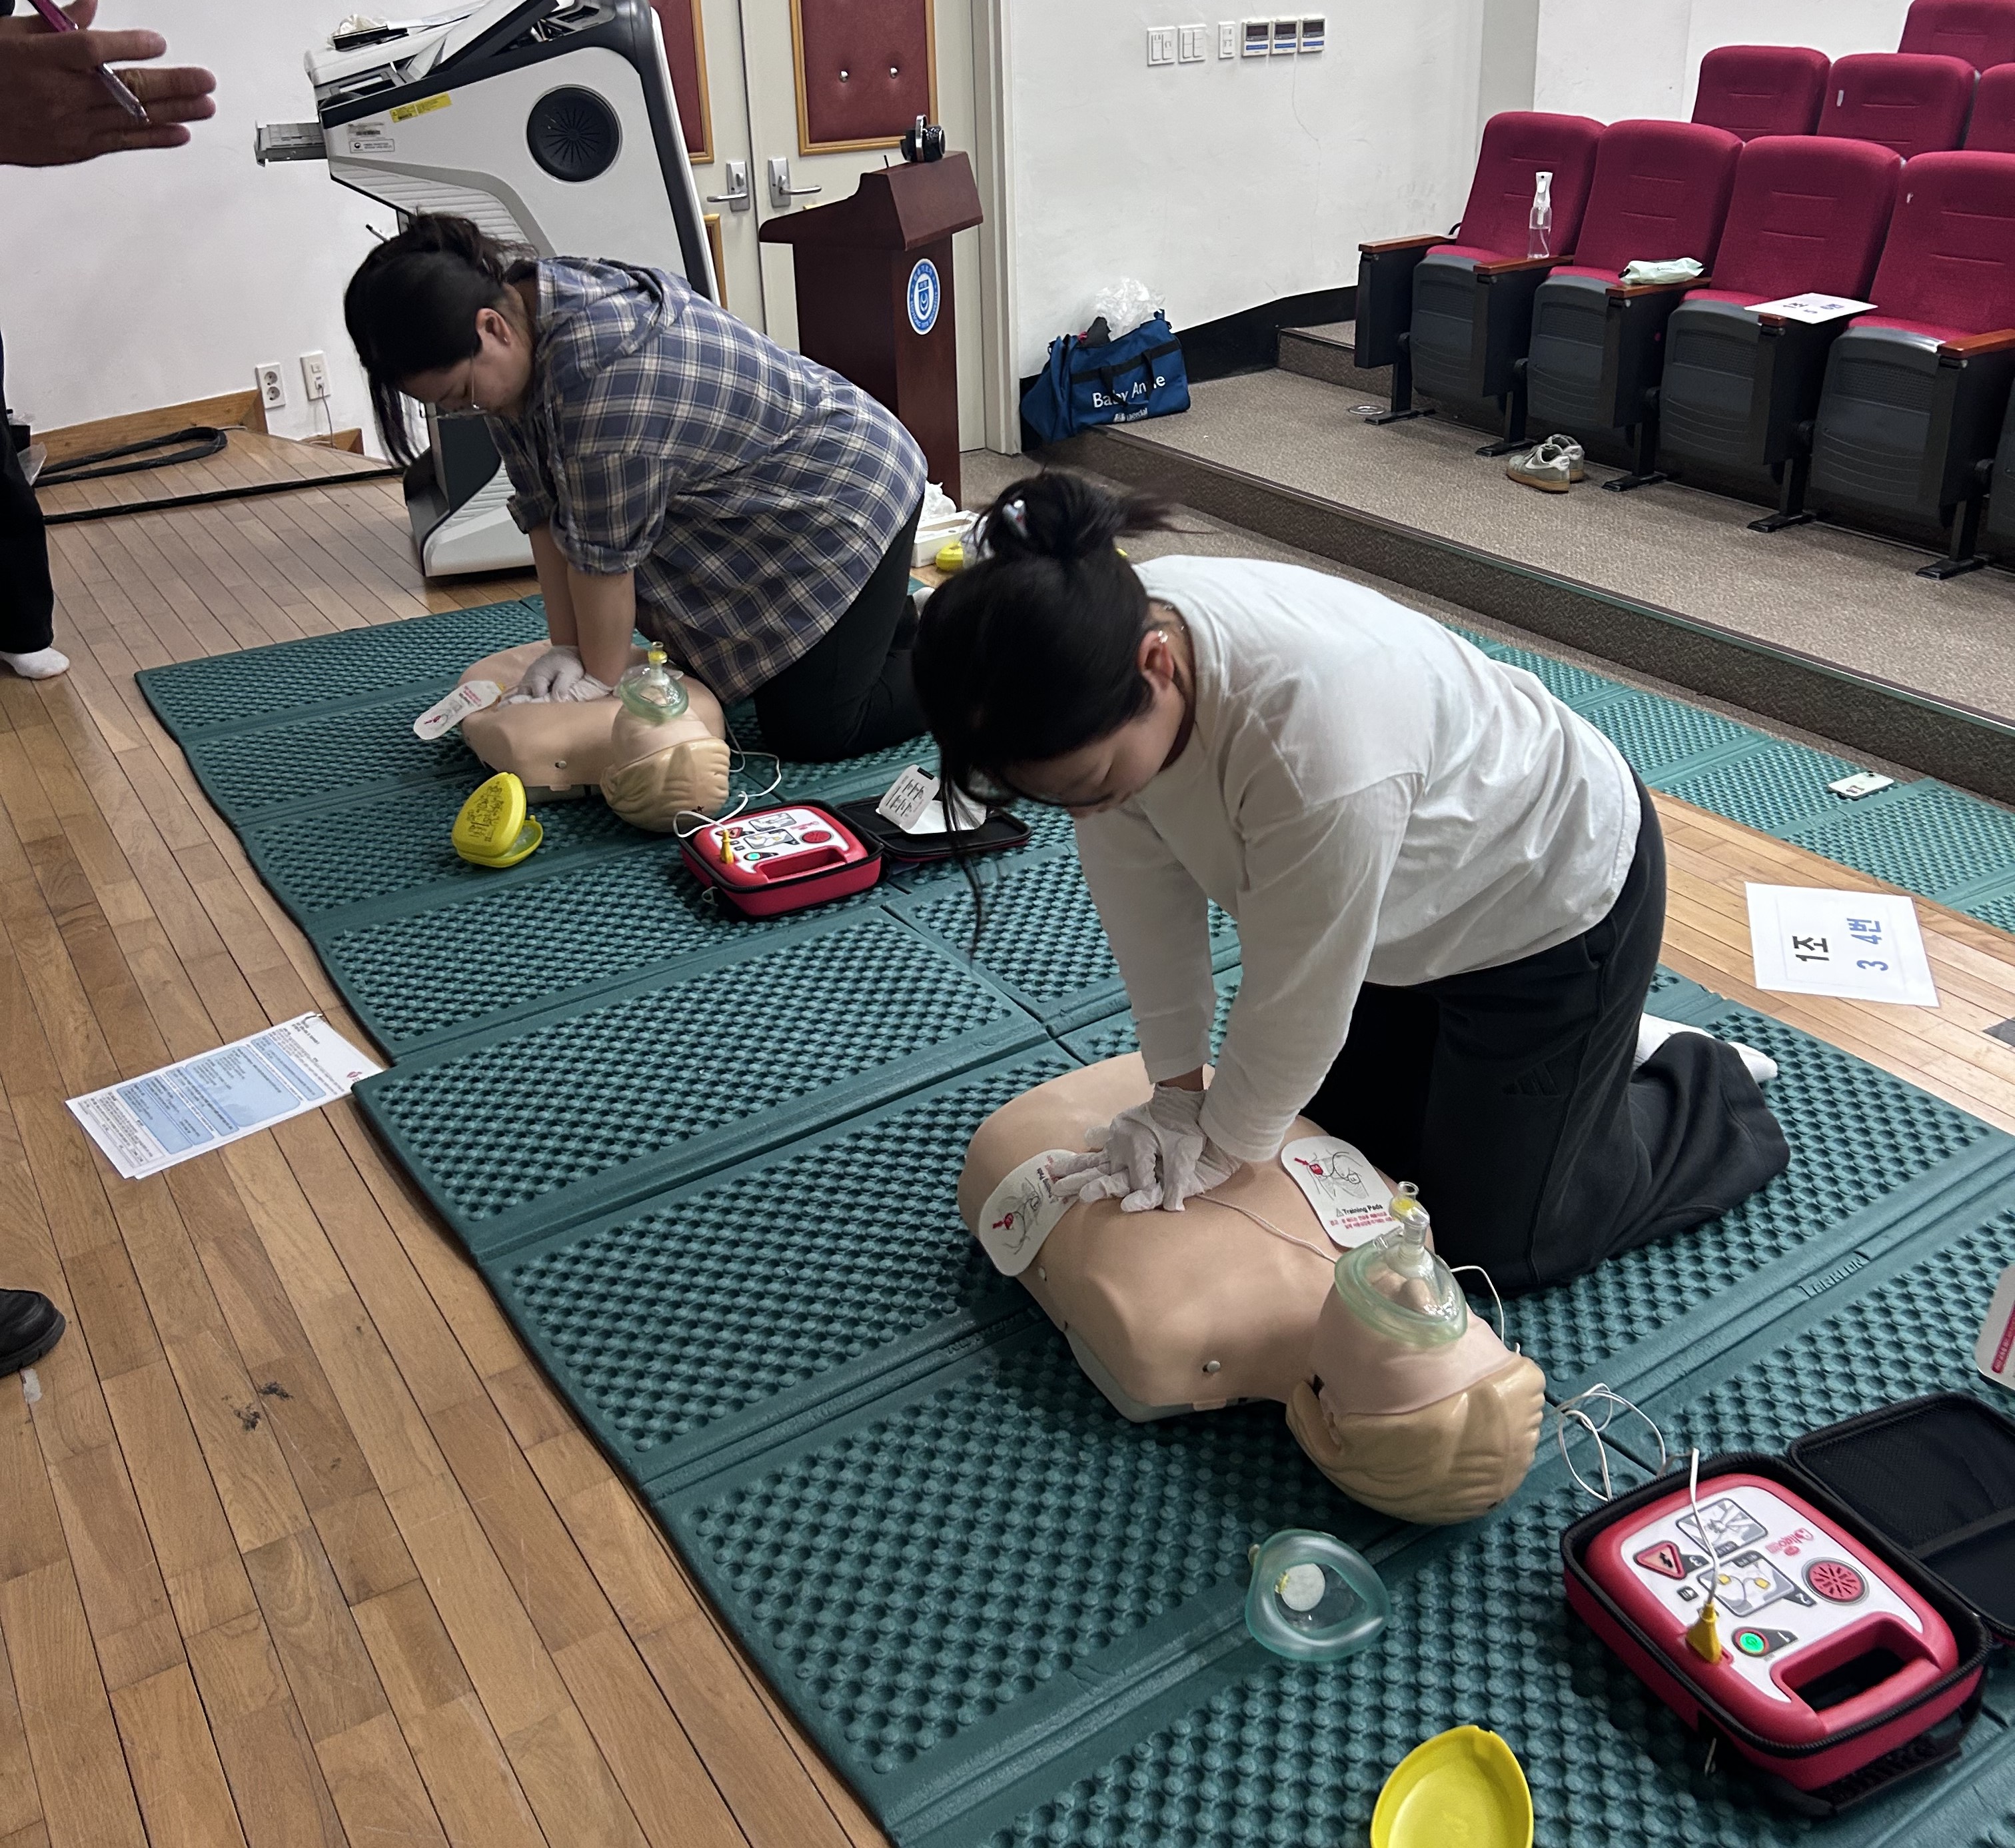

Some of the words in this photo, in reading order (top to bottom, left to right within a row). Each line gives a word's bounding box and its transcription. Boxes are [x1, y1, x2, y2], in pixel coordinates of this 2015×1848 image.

[1131, 376, 1166, 399] Ane
[1846, 918, 1882, 944] 4번
[1792, 935, 1829, 962] 1조
[1856, 960, 1888, 971] 3
[1343, 1206, 1368, 1215] Training
[1795, 1592, 1810, 1604] 2
[1777, 1630, 1790, 1643] 1
